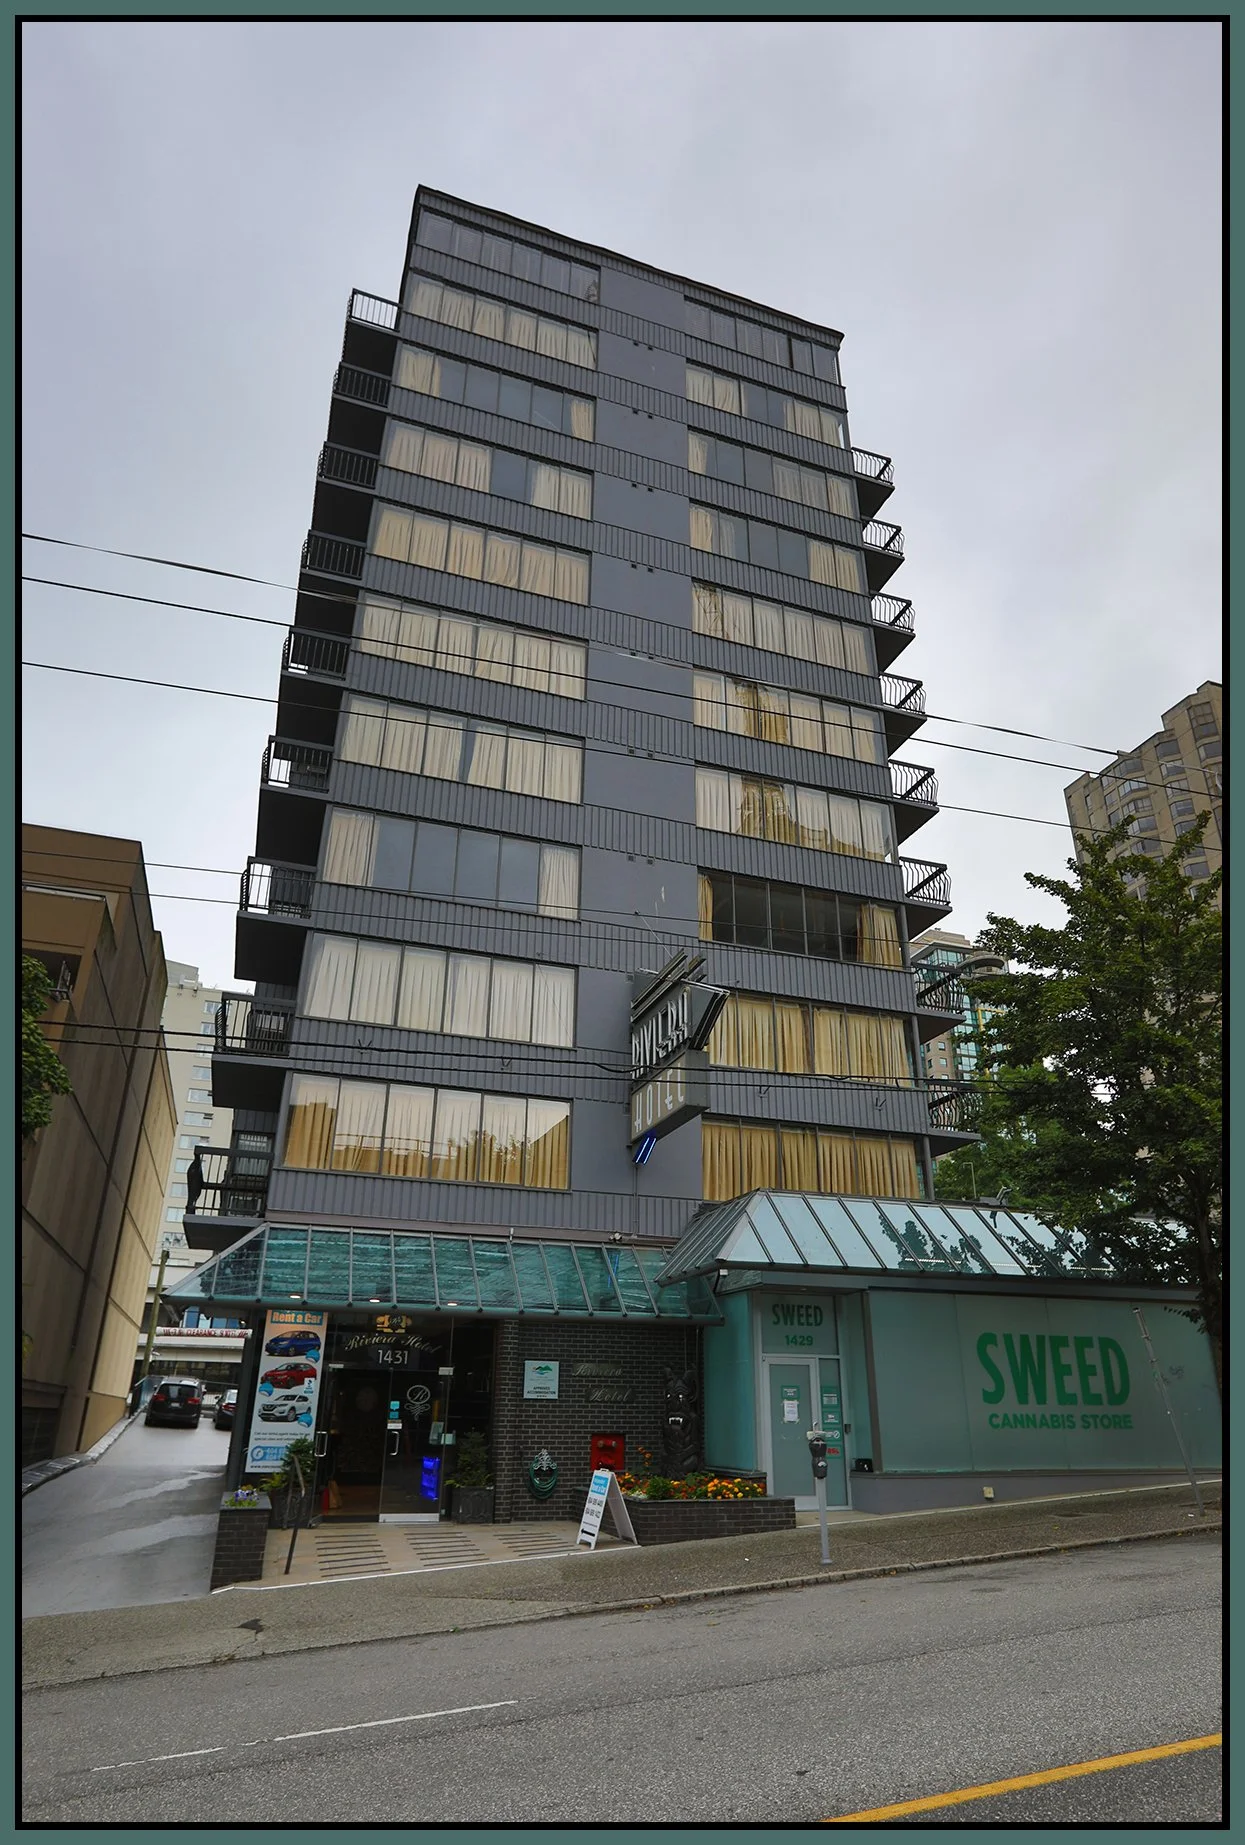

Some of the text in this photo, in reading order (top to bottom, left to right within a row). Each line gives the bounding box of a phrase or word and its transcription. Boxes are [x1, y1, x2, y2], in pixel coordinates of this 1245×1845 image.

[630, 986, 691, 1079] RIVIERA
[634, 1062, 684, 1133] HOTEL
[272, 1311, 322, 1324] Rent a Car
[772, 1303, 823, 1327] SWEED
[345, 1333, 442, 1353] Riviera Hotel
[785, 1335, 814, 1346] 1429
[377, 1349, 409, 1365] 1431
[571, 1363, 623, 1378] Riviera
[976, 1332, 1131, 1406] SWEED
[590, 1387, 632, 1402] Hotel
[988, 1413, 1134, 1430] CANNABIS STORE
